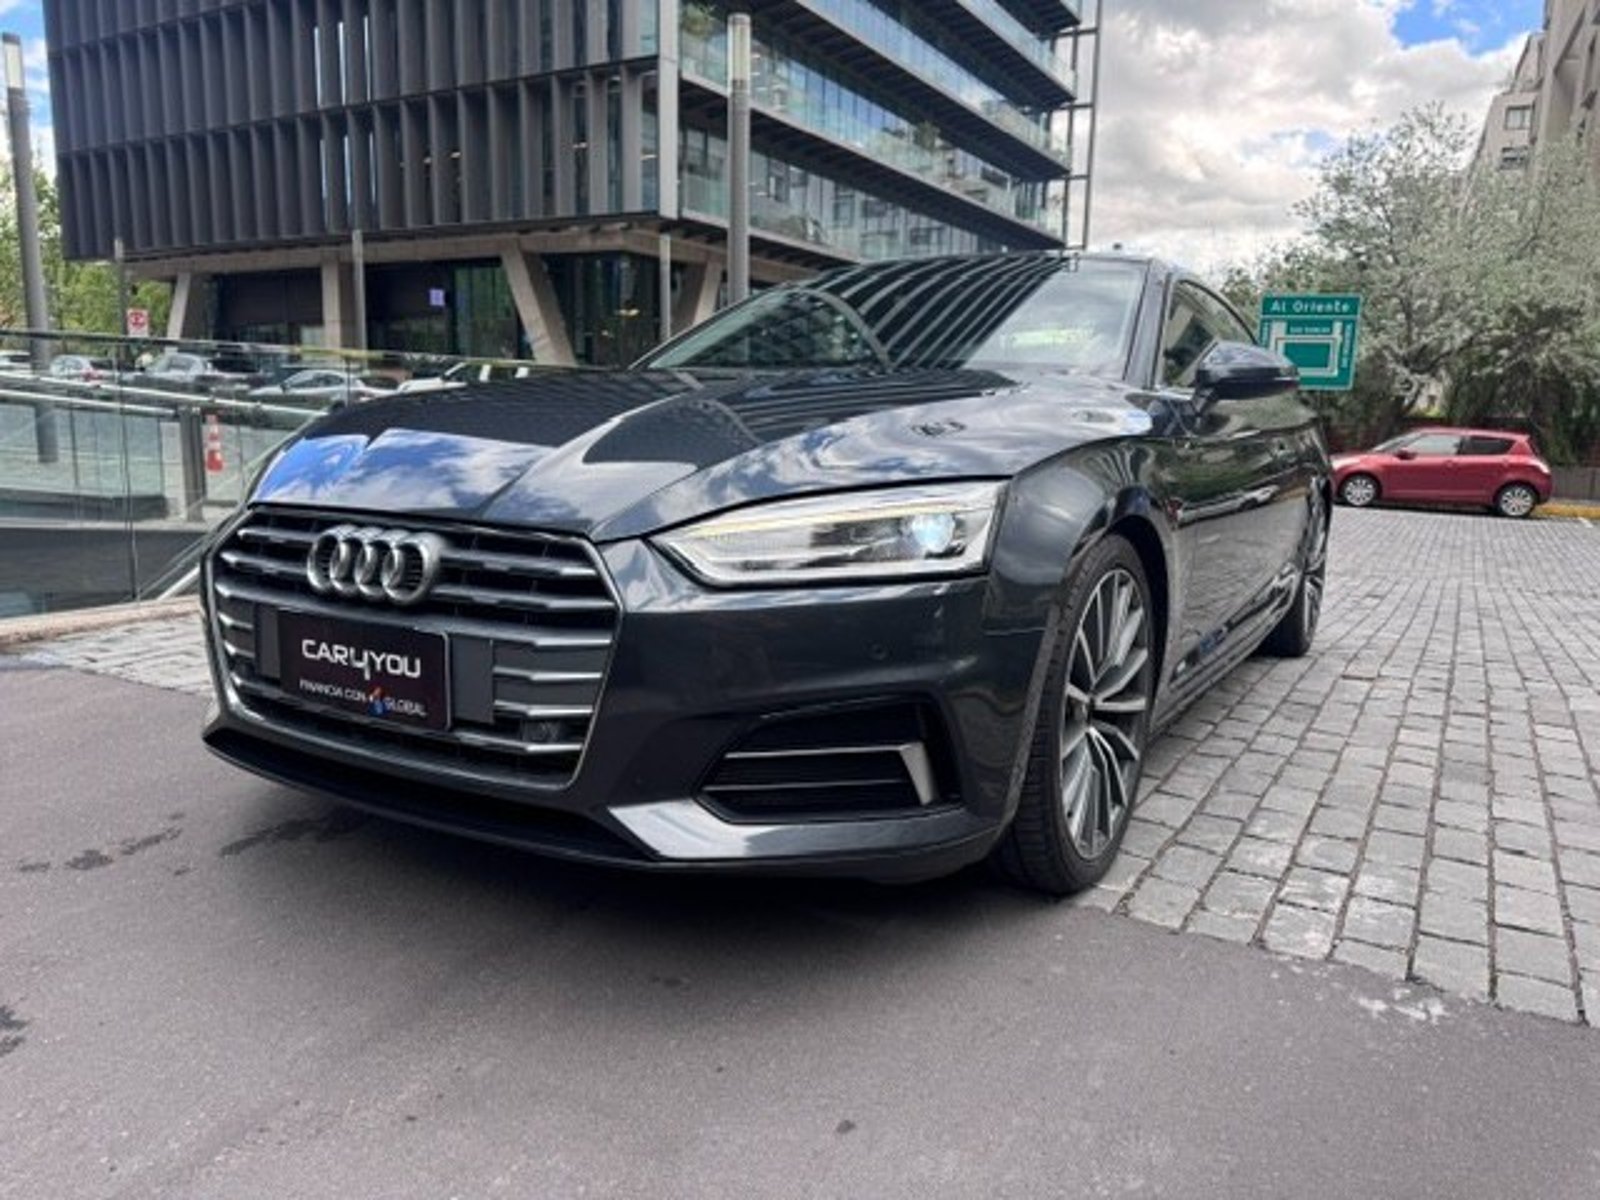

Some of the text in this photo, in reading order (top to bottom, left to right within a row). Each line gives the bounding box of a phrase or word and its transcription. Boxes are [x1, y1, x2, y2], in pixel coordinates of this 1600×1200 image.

[1270, 299, 1350, 313] Al Oriente
[301, 639, 421, 680] CAR4YOU
[300, 679, 343, 698] FINANCIA
[384, 697, 427, 717] GLOBAL
